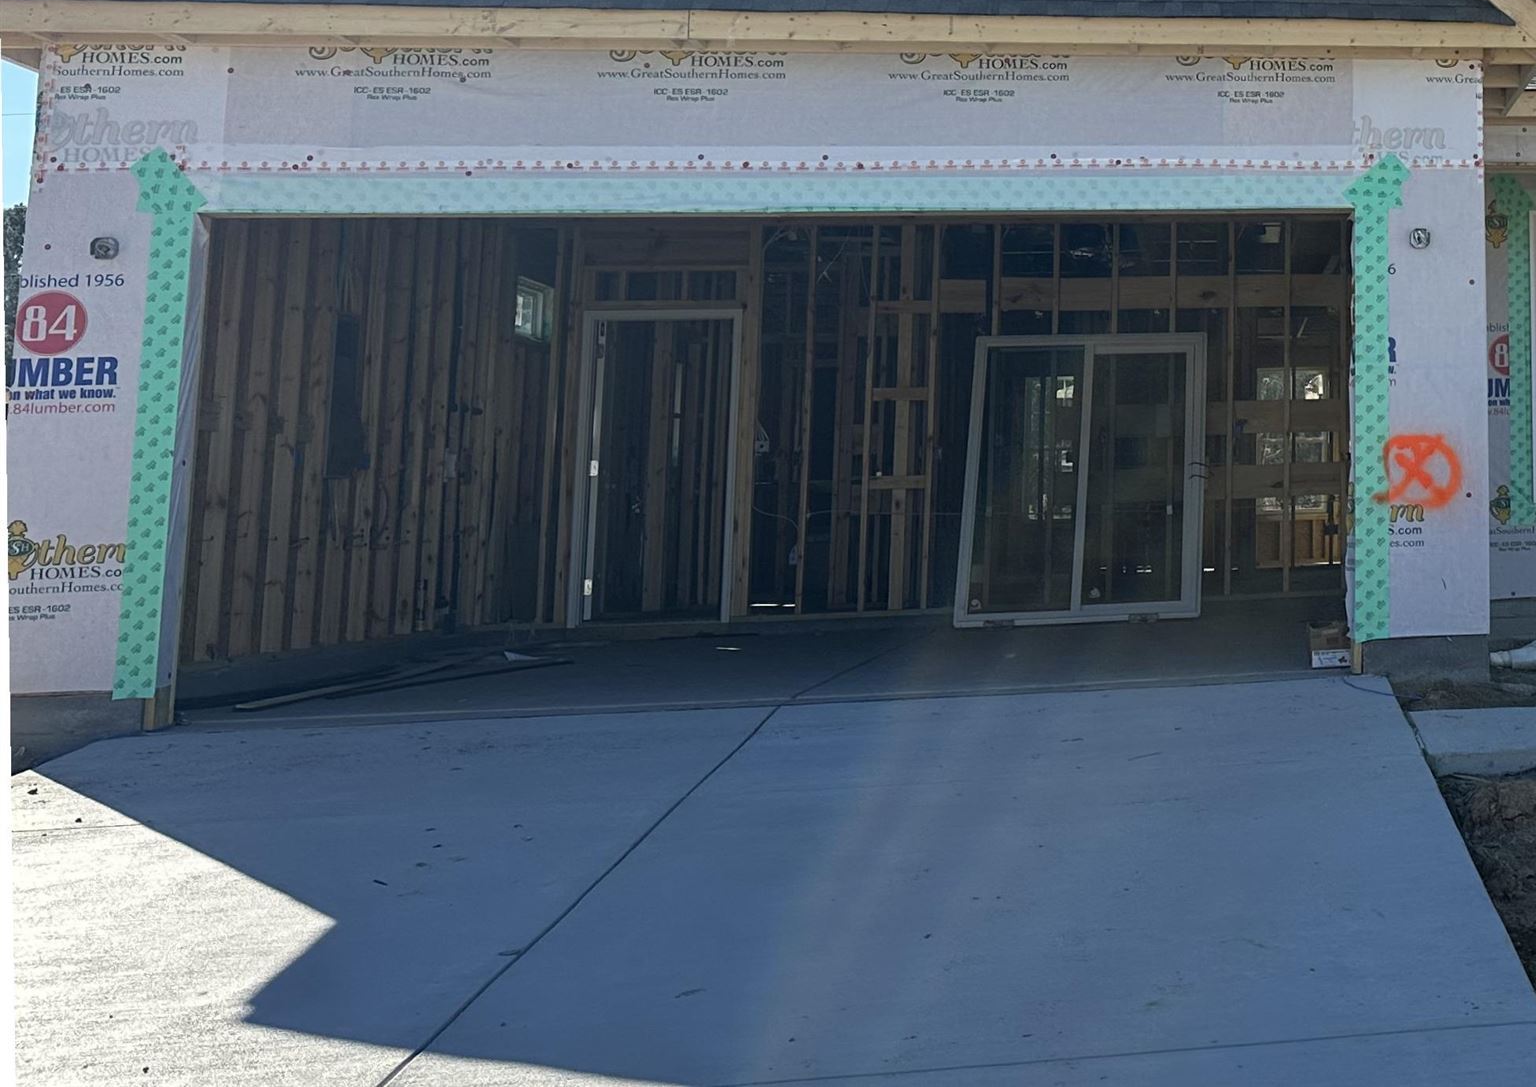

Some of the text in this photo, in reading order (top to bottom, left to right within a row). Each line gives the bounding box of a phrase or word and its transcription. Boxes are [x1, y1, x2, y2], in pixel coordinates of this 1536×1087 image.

[82, 52, 182, 64] HOMES.com
[392, 54, 489, 67] HOMES.com
[691, 56, 784, 68] HOMES.com
[979, 58, 1067, 70] HOMES.com
[56, 65, 184, 77] SouthernHomes.com
[1250, 60, 1333, 71] HOMES.com
[20, 274, 124, 288] blished 1956
[22, 305, 77, 341] 84
[6, 356, 118, 388] MBER
[25, 388, 116, 400] what we know.
[10, 402, 115, 414] .84lumber.com
[31, 566, 122, 580] HOMES.co
